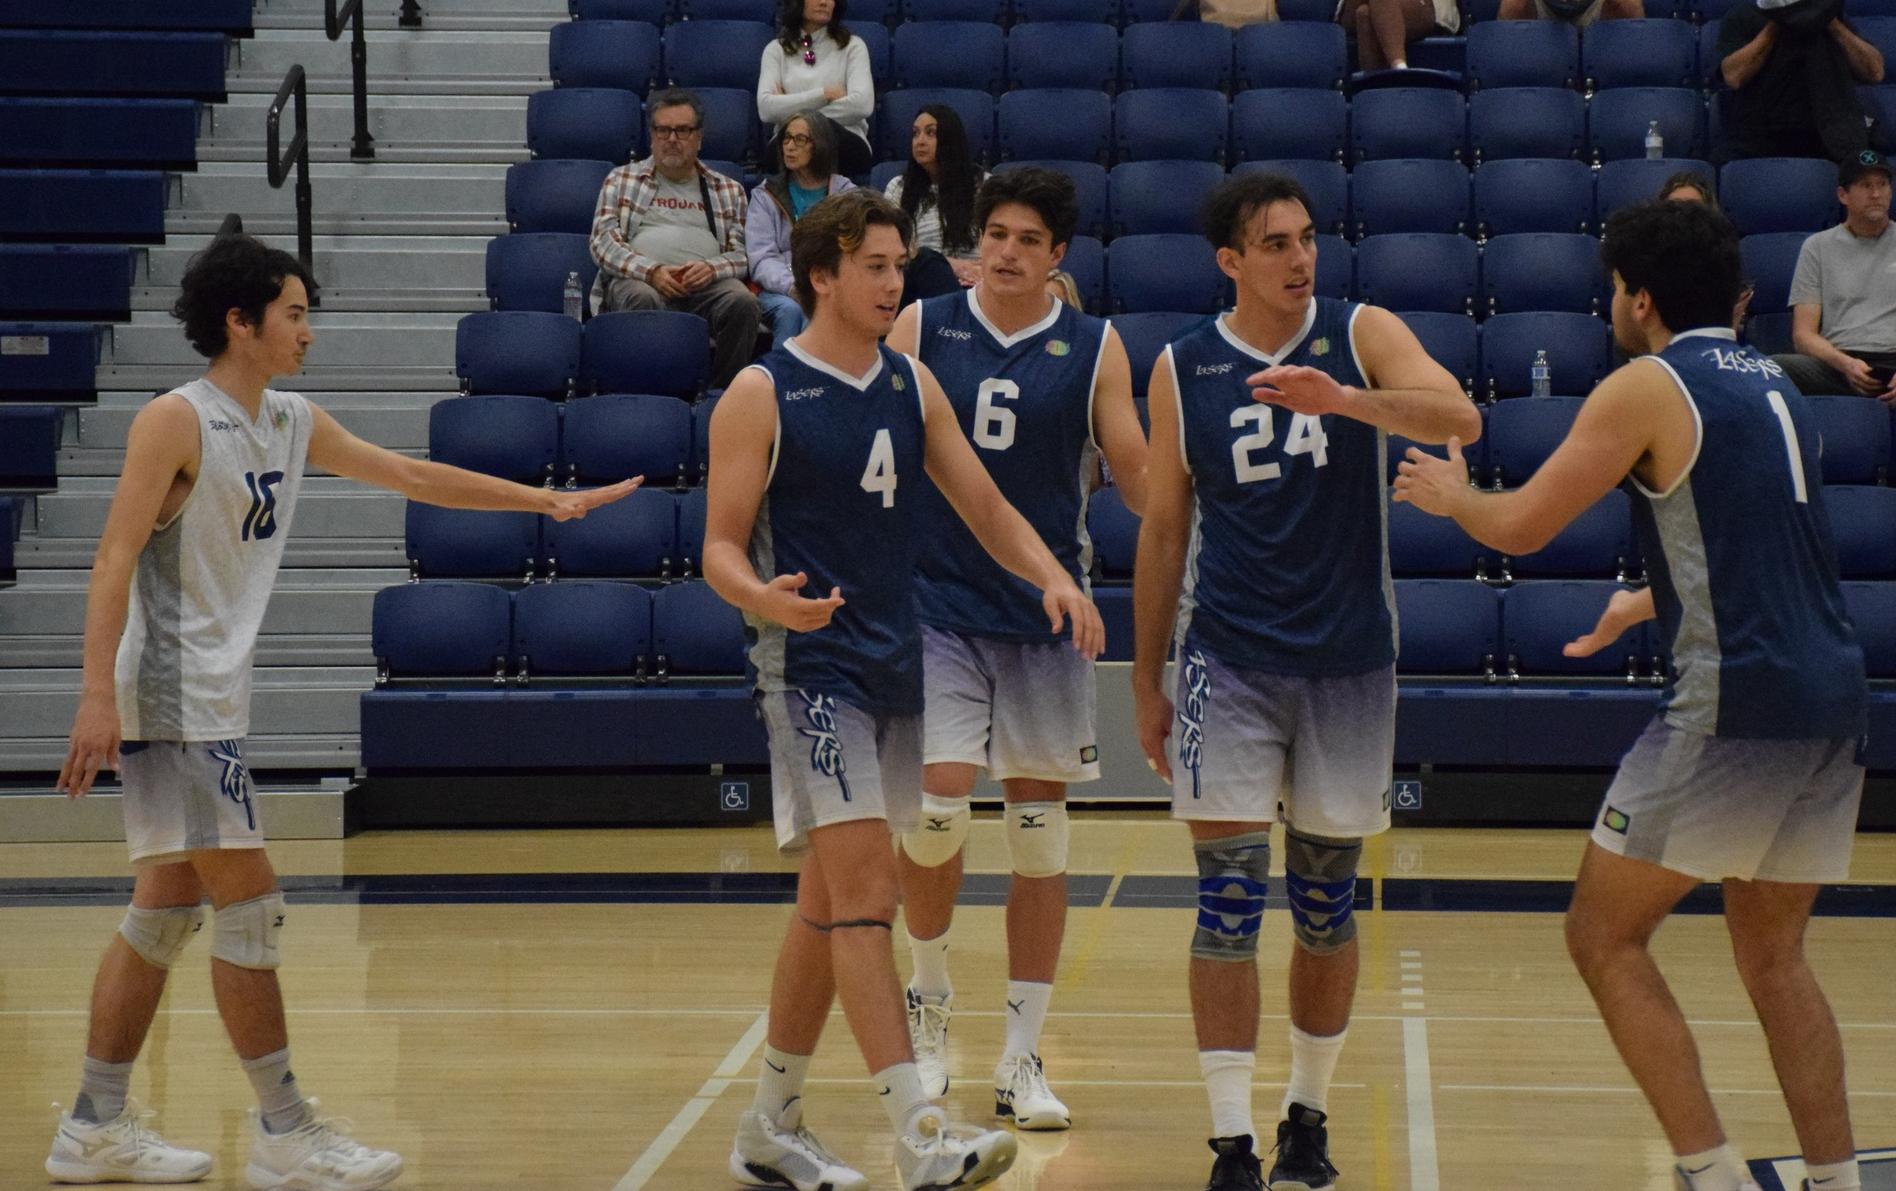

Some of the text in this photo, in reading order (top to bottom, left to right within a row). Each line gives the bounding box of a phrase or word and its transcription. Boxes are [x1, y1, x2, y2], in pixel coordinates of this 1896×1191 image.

[973, 377, 1020, 451] 6
[1230, 403, 1329, 484] 24
[1766, 390, 1808, 504] 1
[241, 470, 285, 542] 16
[860, 428, 898, 509] 4
